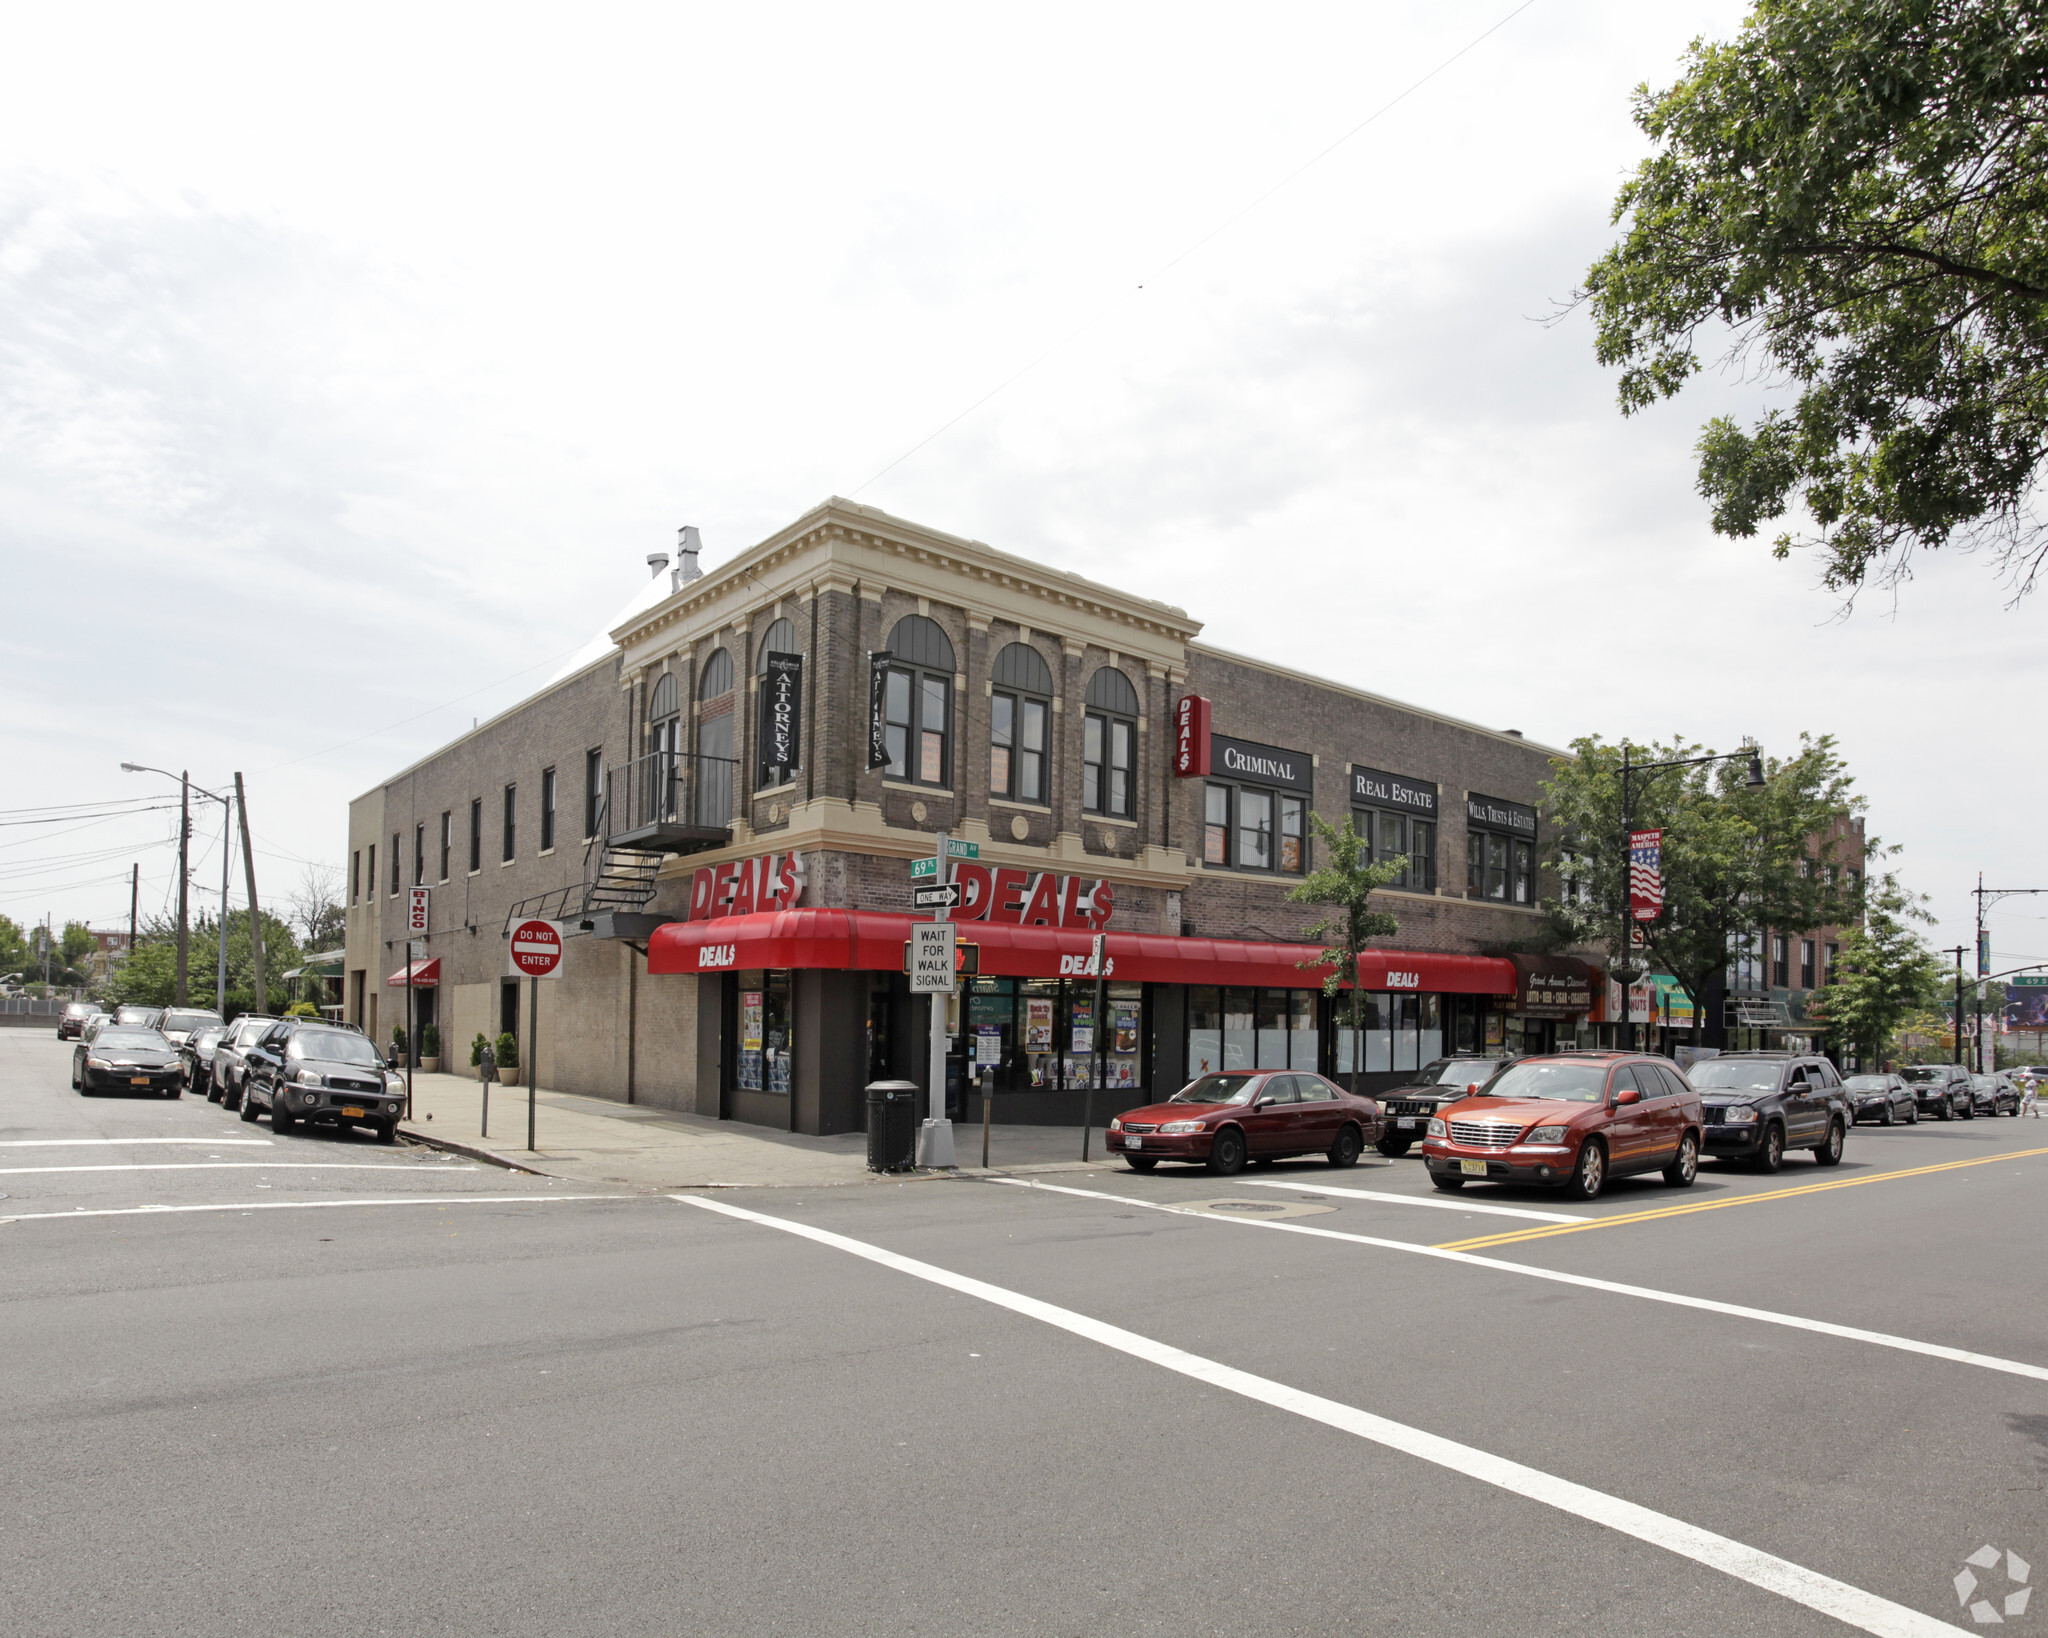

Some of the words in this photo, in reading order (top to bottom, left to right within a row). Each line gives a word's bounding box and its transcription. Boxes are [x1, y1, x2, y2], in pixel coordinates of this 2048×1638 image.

[774, 673, 791, 762] ATTORNEYS
[1180, 700, 1190, 771] DEAL$
[1224, 748, 1295, 780] CRIMINAL
[1356, 775, 1389, 799] REAL
[1392, 783, 1432, 808] ESTATE
[1468, 801, 1487, 823] WILLS,
[1488, 805, 1507, 825] TRUSTS
[1508, 810, 1513, 825] &
[1513, 811, 1535, 831] ESTATES
[1632, 832, 1660, 841] MASPETH
[948, 841, 968, 856] GRAND
[970, 844, 977, 852] AV
[1632, 840, 1660, 849] AMERICA
[914, 862, 927, 875] 69
[688, 850, 800, 922] DEAL$
[920, 893, 933, 904] ONE
[938, 891, 953, 901] WAY
[950, 862, 1114, 930] DEAL$
[412, 891, 426, 928] BINGO
[520, 930, 533, 940] DO
[535, 931, 553, 941] NOT
[921, 931, 946, 941] WAIT
[699, 944, 735, 967] DEAL$
[923, 945, 944, 956] FOR
[521, 955, 551, 966] ENTER
[918, 960, 948, 971] WALK
[1060, 955, 1113, 977] DEA$
[916, 975, 949, 986] SIGNAL
[1386, 971, 1419, 988] DEAL$
[1529, 973, 1547, 988] Grand
[1548, 974, 1566, 987] Avenue
[1526, 990, 1539, 1003] LOTTO
[1542, 991, 1553, 1004] BEER
[1555, 992, 1568, 1004] CIGAR
[1570, 992, 1591, 1005] CIGARETTE
